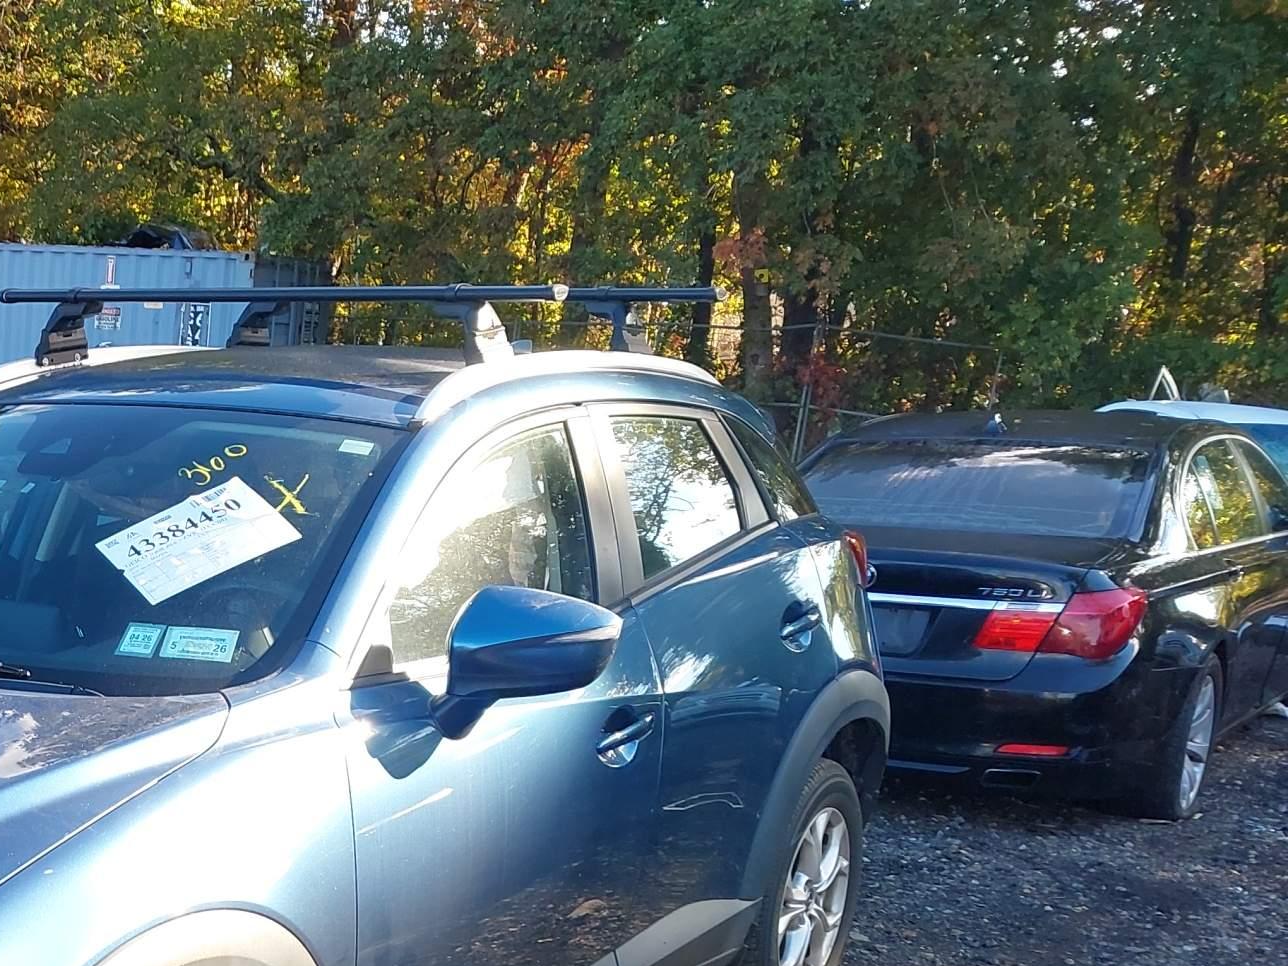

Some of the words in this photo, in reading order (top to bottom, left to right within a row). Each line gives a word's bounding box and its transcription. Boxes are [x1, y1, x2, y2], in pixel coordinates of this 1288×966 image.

[127, 498, 241, 558] 43384450
[142, 634, 153, 642] 26
[169, 641, 178, 650] 5
[213, 644, 228, 653] 26
